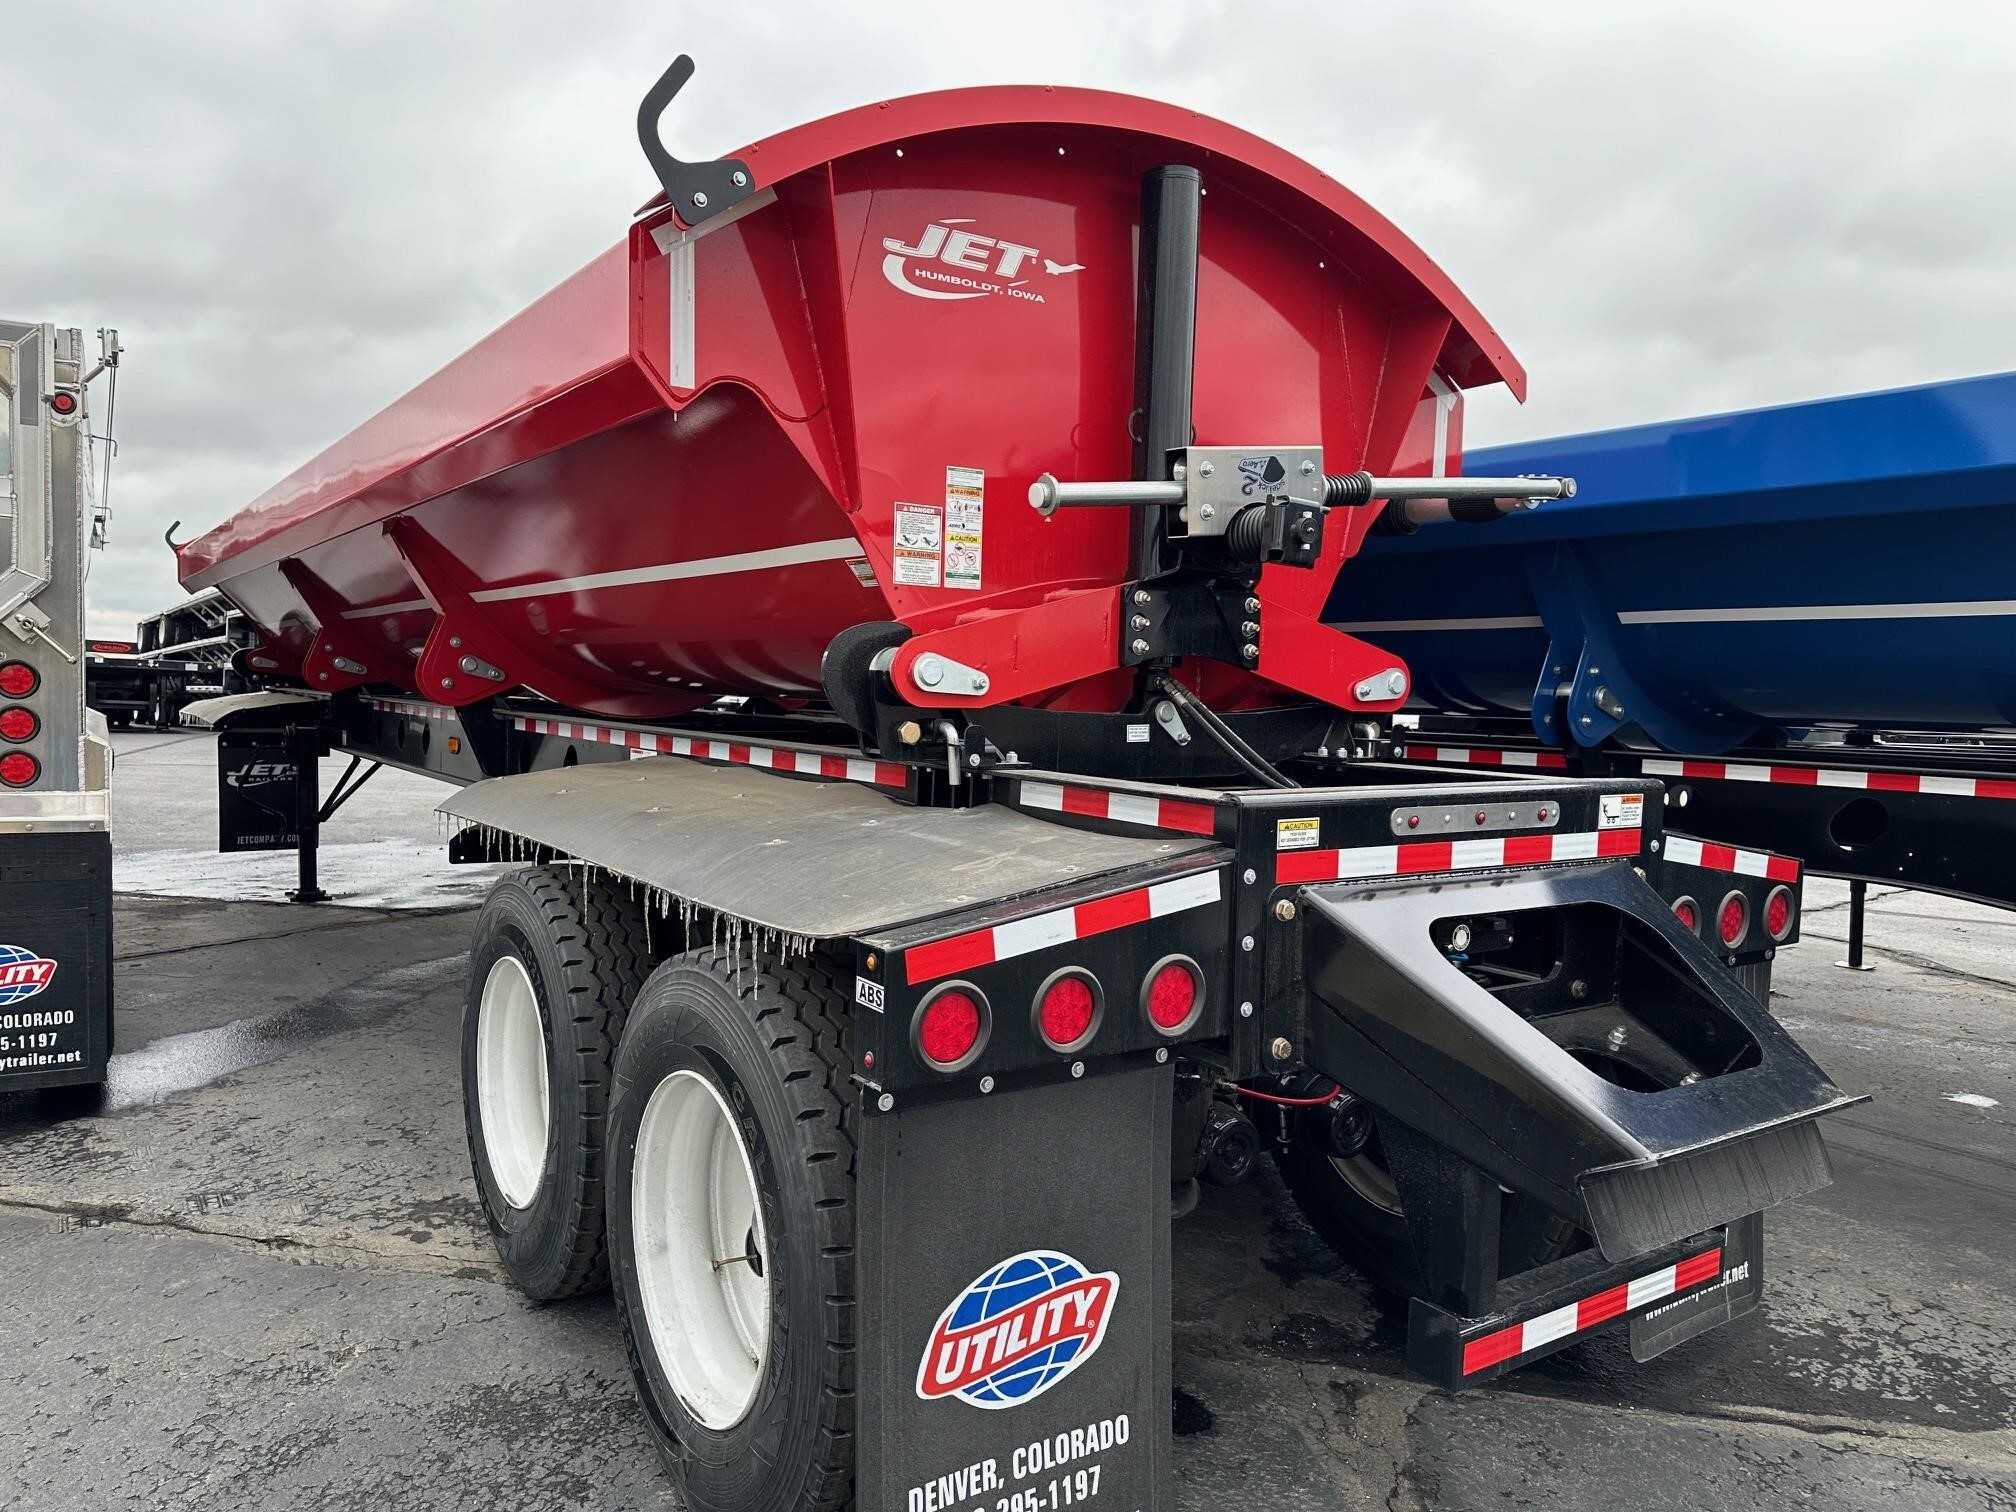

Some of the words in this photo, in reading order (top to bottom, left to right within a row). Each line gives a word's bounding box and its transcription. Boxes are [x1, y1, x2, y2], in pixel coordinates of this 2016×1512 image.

[882, 223, 1040, 278] JET
[1007, 288, 1045, 304] IOWA
[910, 506, 935, 514] DANGER
[955, 535, 978, 543] CAUTION
[907, 551, 936, 559] WARNING
[227, 764, 290, 776] JET
[1290, 822, 1313, 830] CAUTION
[0, 964, 50, 984] ITY
[859, 982, 883, 1008] ABS
[0, 1009, 74, 1029] OLORADO
[935, 1286, 1103, 1385] UTILITY
[908, 1458, 1005, 1512] DENVER,
[1012, 1414, 1130, 1480] COLORADO
